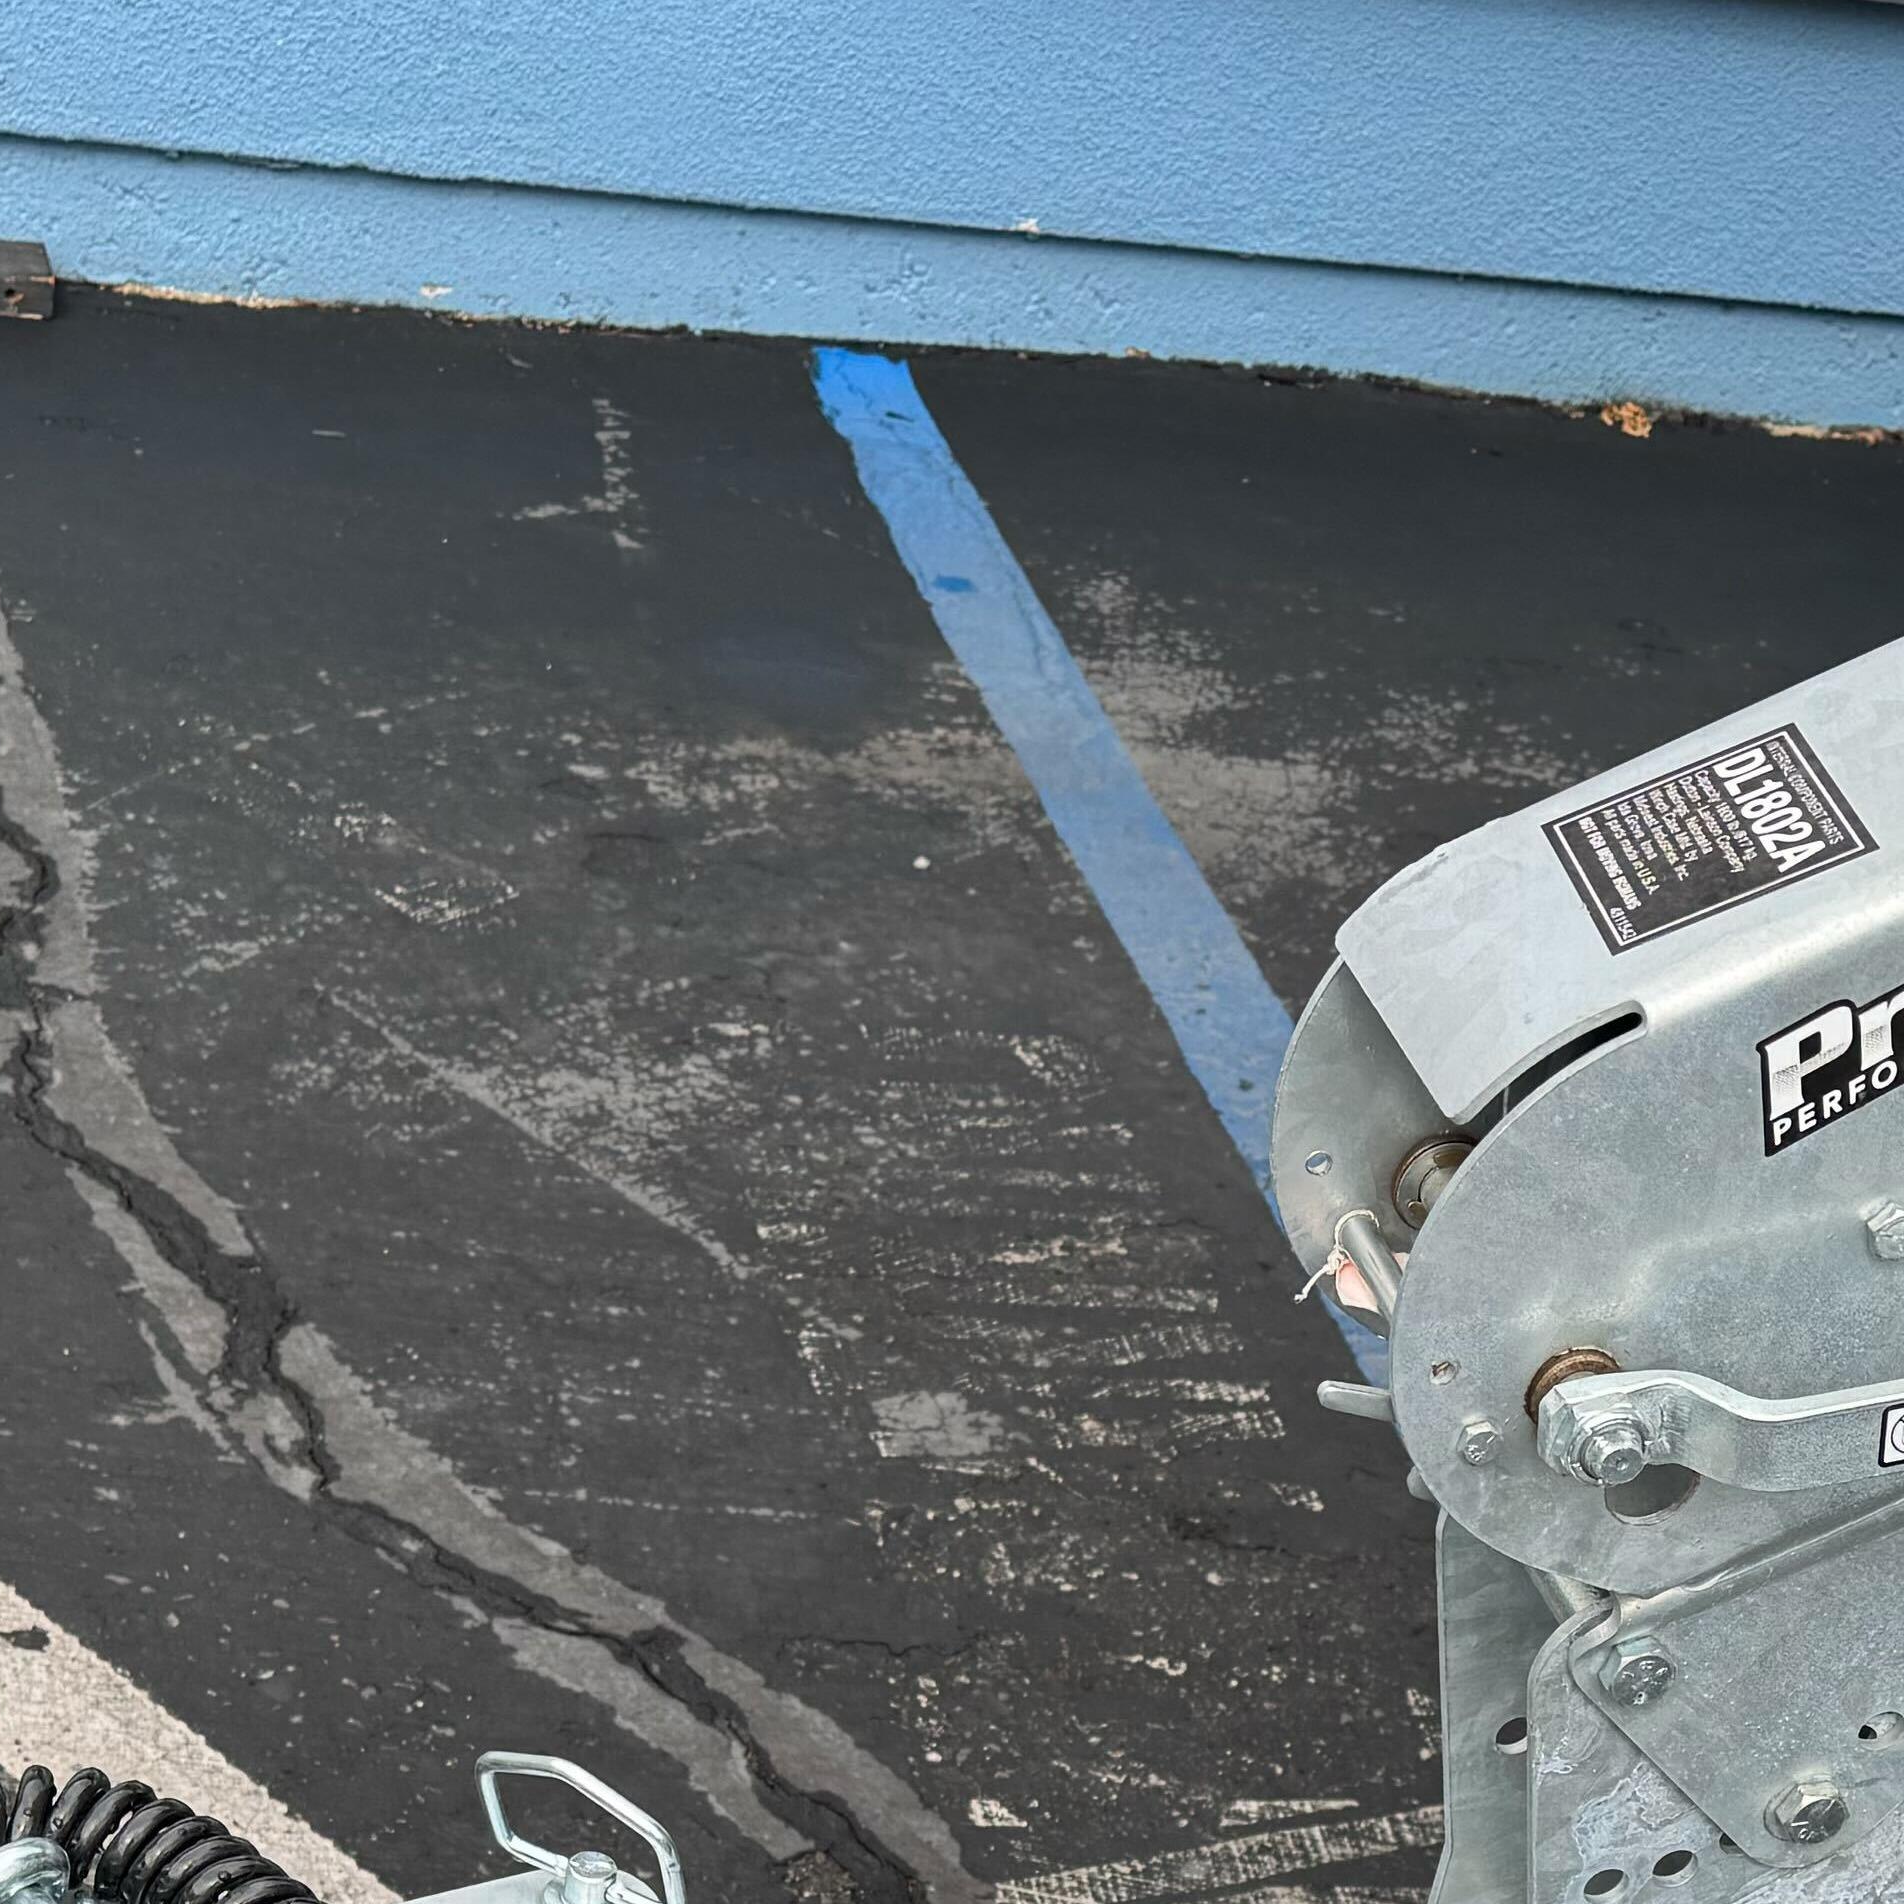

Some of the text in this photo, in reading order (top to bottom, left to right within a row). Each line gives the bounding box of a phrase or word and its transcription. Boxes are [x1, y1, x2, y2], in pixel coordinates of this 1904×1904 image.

[1713, 748, 1828, 871] DL1802A
[1587, 832, 1605, 848] FOR
[1605, 818, 1627, 839] parts
[1818, 818, 1844, 843] PARTS
[1713, 835, 1746, 873] Company
